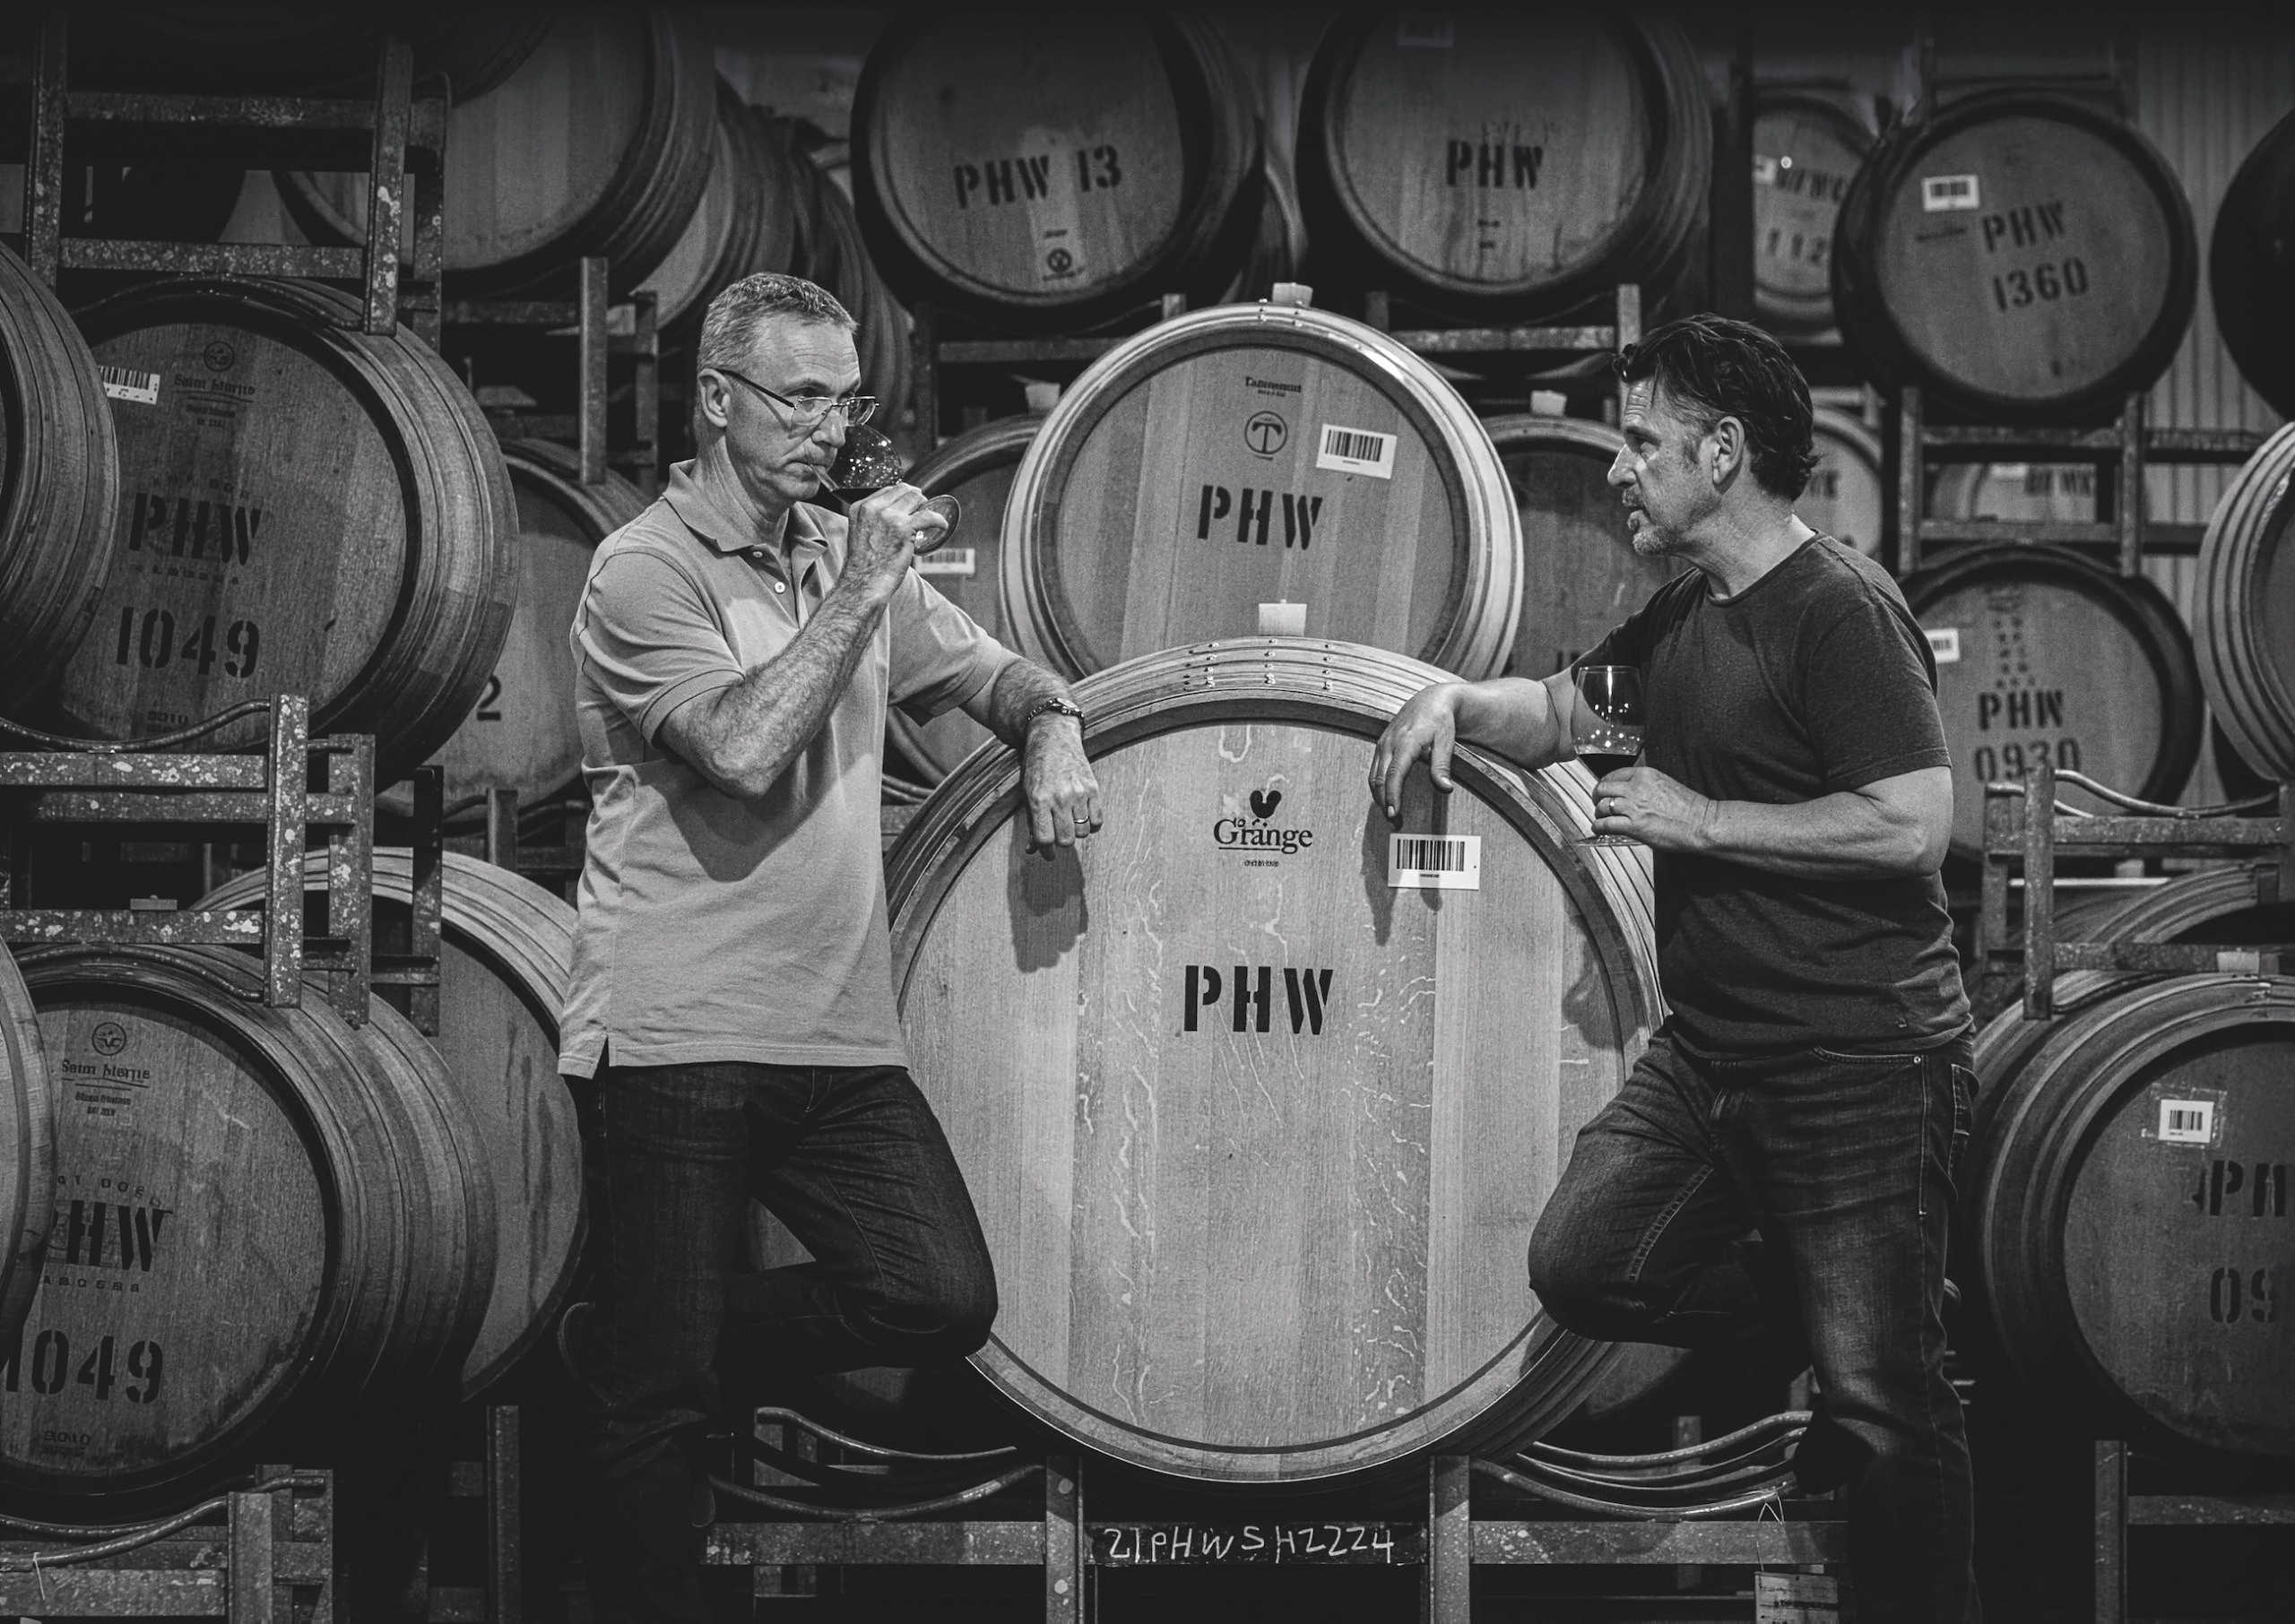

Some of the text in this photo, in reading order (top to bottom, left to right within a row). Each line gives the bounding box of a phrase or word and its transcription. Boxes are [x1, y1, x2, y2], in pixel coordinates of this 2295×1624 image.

[954, 144, 1122, 209] PHW 13
[1445, 141, 1544, 190] PHW
[1982, 199, 2065, 254] PHW
[1992, 256, 2090, 313] 1360
[129, 493, 262, 566] PHW
[1197, 484, 1323, 549] PHW
[116, 607, 259, 678] 1049
[1978, 687, 2064, 732] PHW
[1213, 817, 1313, 854] Grange
[1182, 964, 1334, 1035] PHW
[54, 1199, 167, 1272] HW
